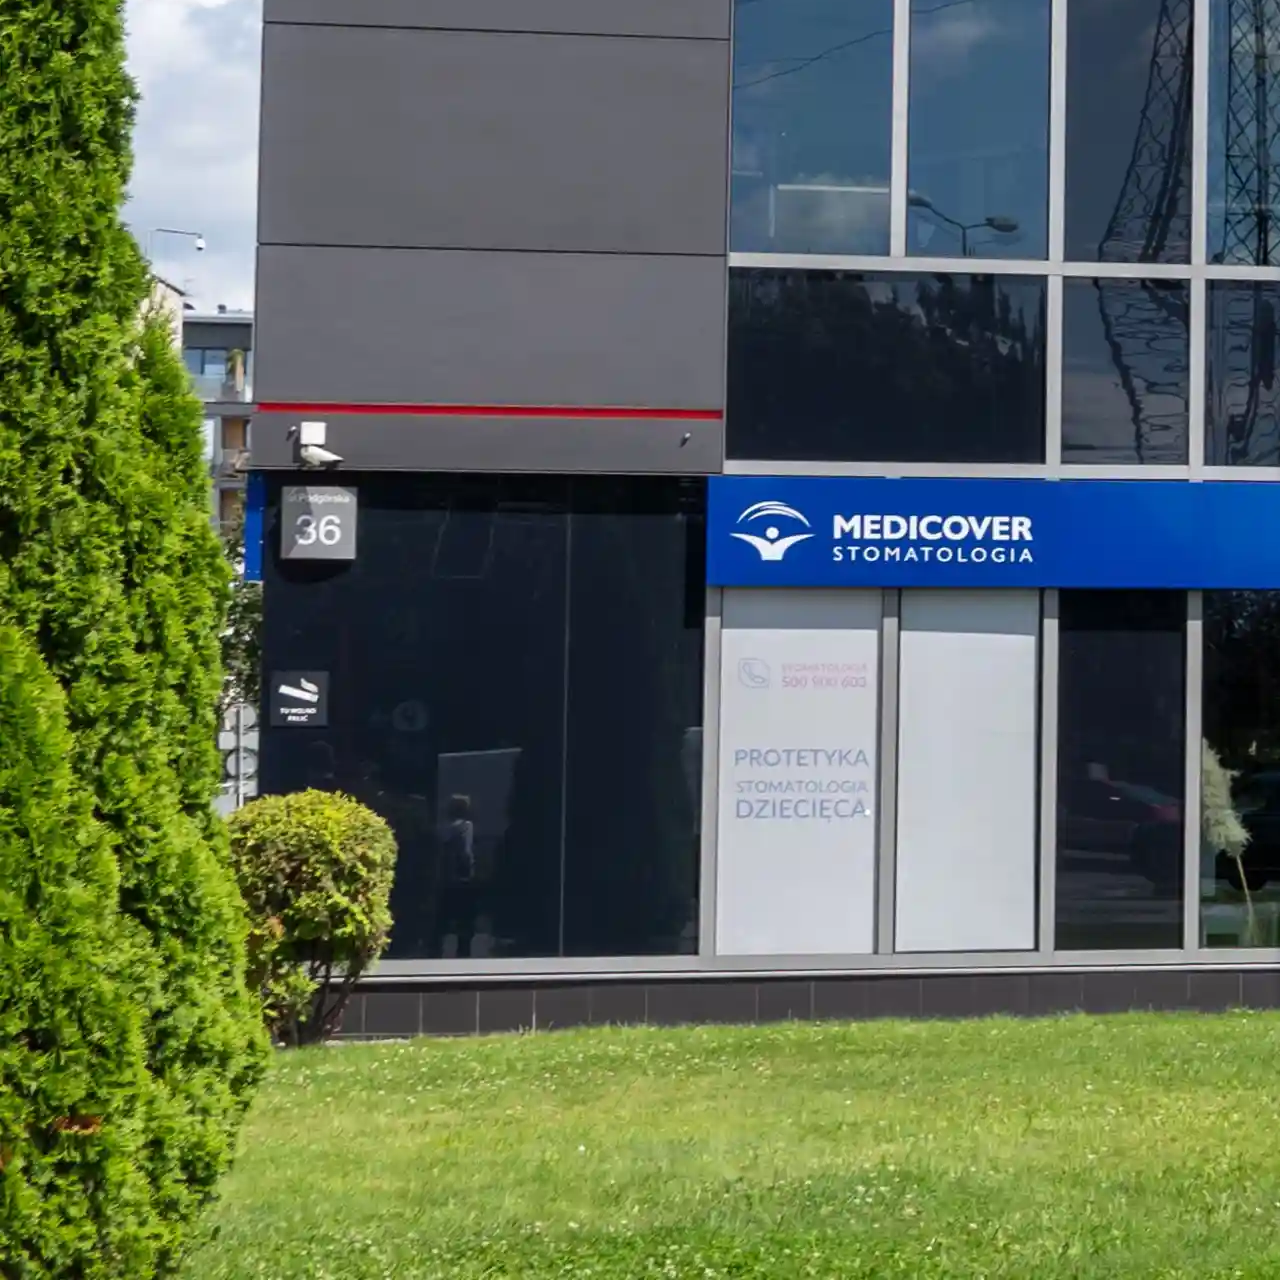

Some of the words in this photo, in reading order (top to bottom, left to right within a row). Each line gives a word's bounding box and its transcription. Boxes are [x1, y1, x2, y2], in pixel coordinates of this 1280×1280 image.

[295, 514, 341, 546] 36
[833, 514, 1034, 540] MEDICOVER
[833, 546, 1034, 562] STOMATOLOGIA
[734, 749, 869, 768] PROTETYKA
[736, 780, 868, 794] STOMATOLOGIA
[735, 798, 867, 823] DZIECIĘCA
